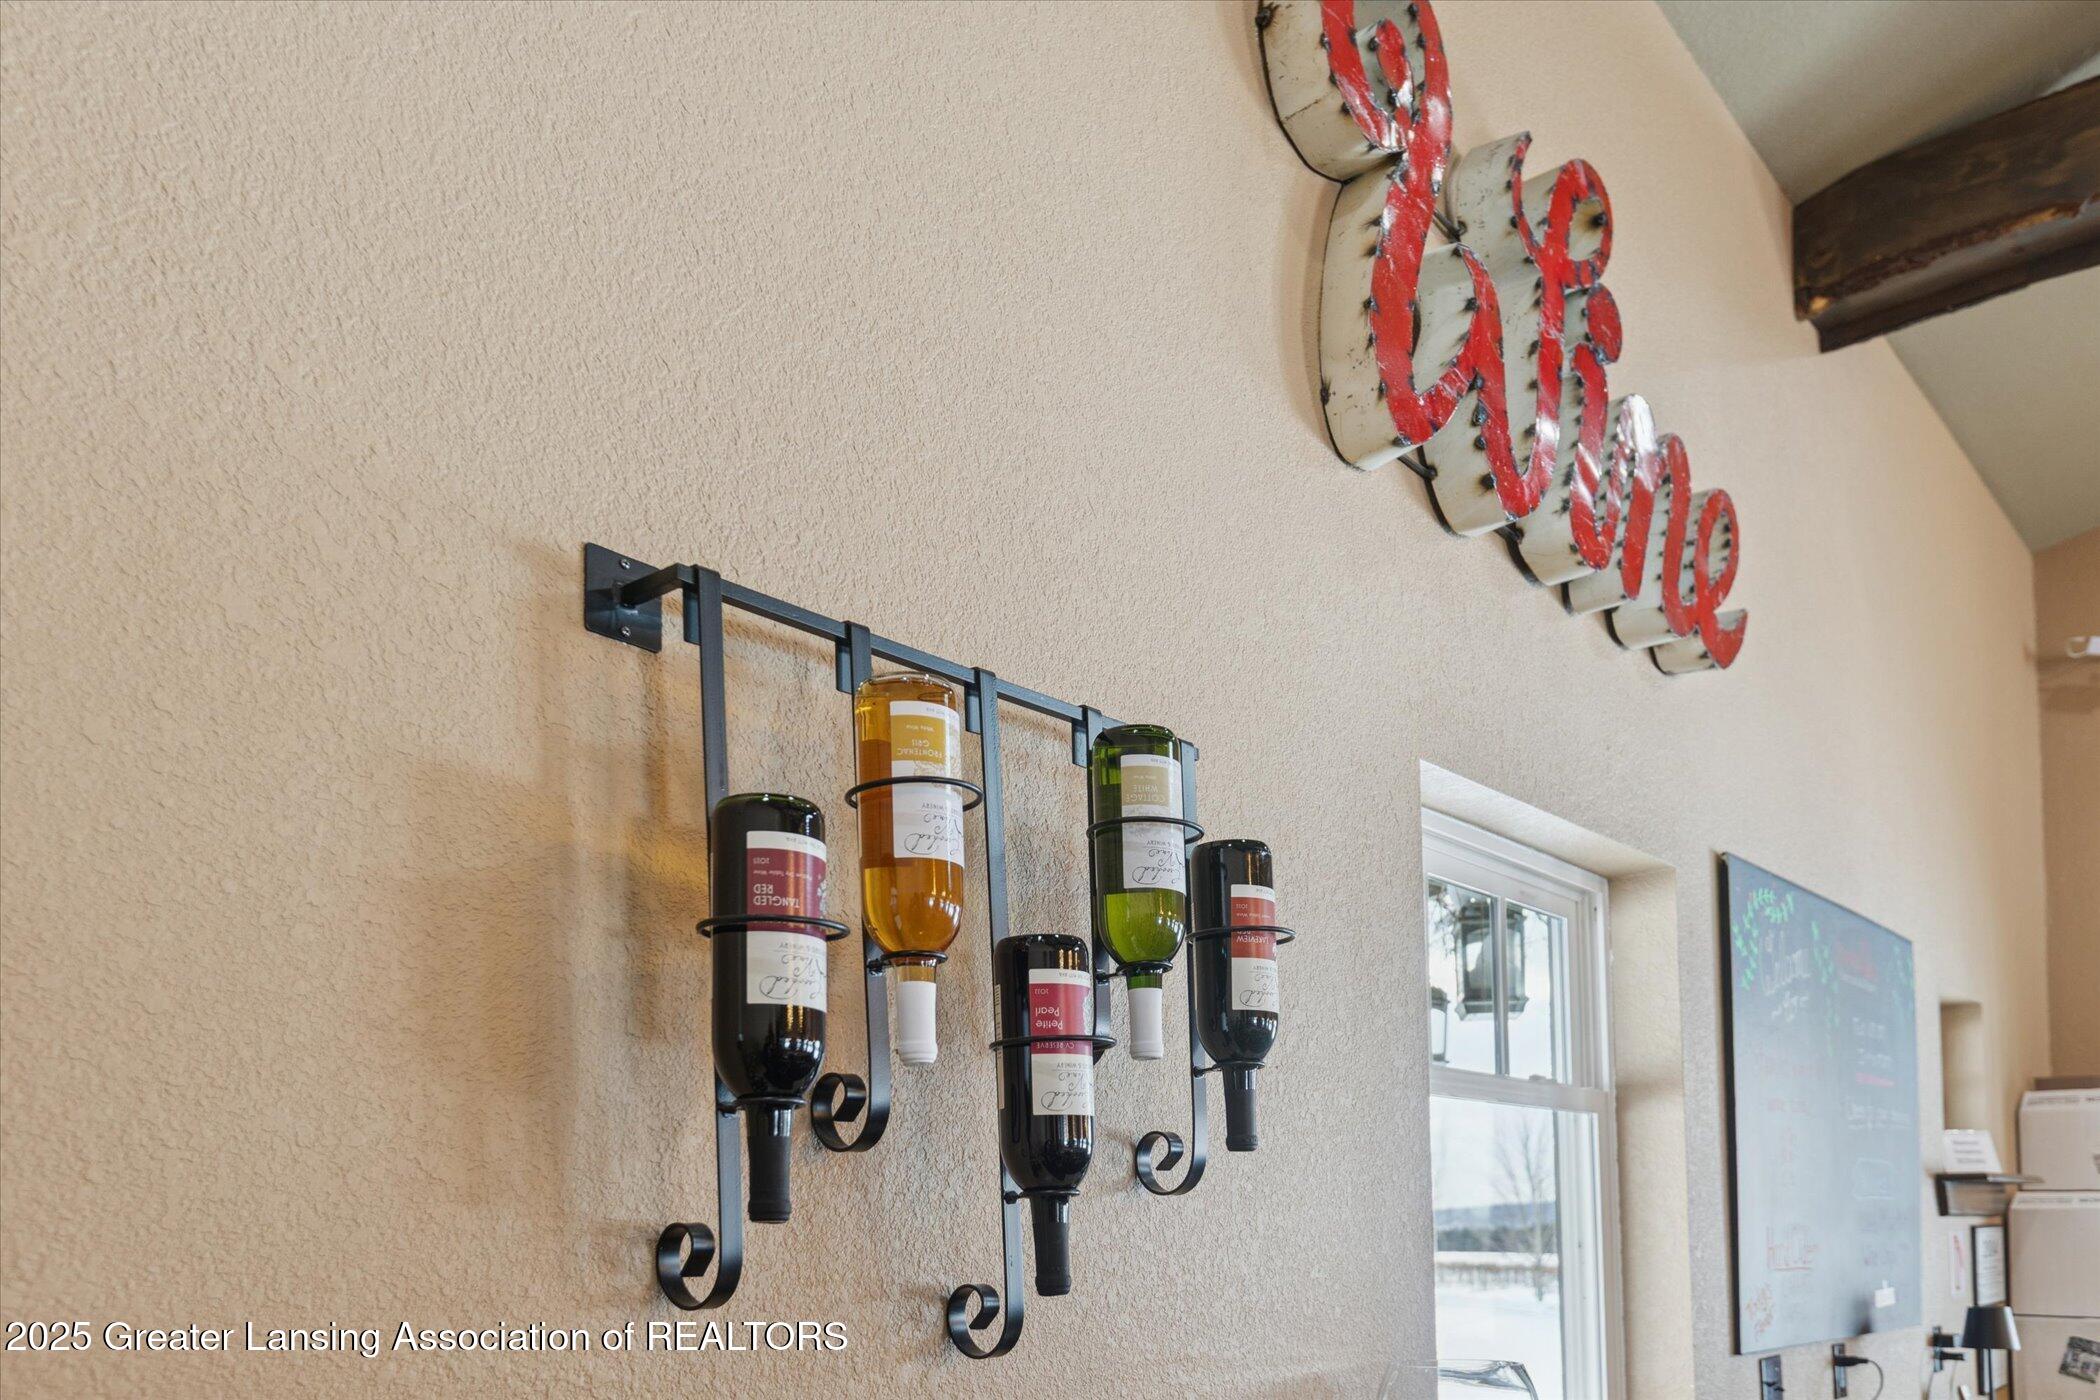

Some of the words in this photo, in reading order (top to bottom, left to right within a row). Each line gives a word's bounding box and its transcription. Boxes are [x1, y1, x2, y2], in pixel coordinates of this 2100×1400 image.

[897, 748, 942, 758] FRONTENAC
[1132, 784, 1158, 792] WHITE
[1125, 793, 1165, 802] COTTAGE
[753, 884, 773, 894] RED
[753, 895, 800, 908] TANGLED
[1236, 935, 1269, 944] LAKEVIEW
[1035, 1007, 1060, 1016] Pearl
[1035, 1020, 1063, 1030] Petite
